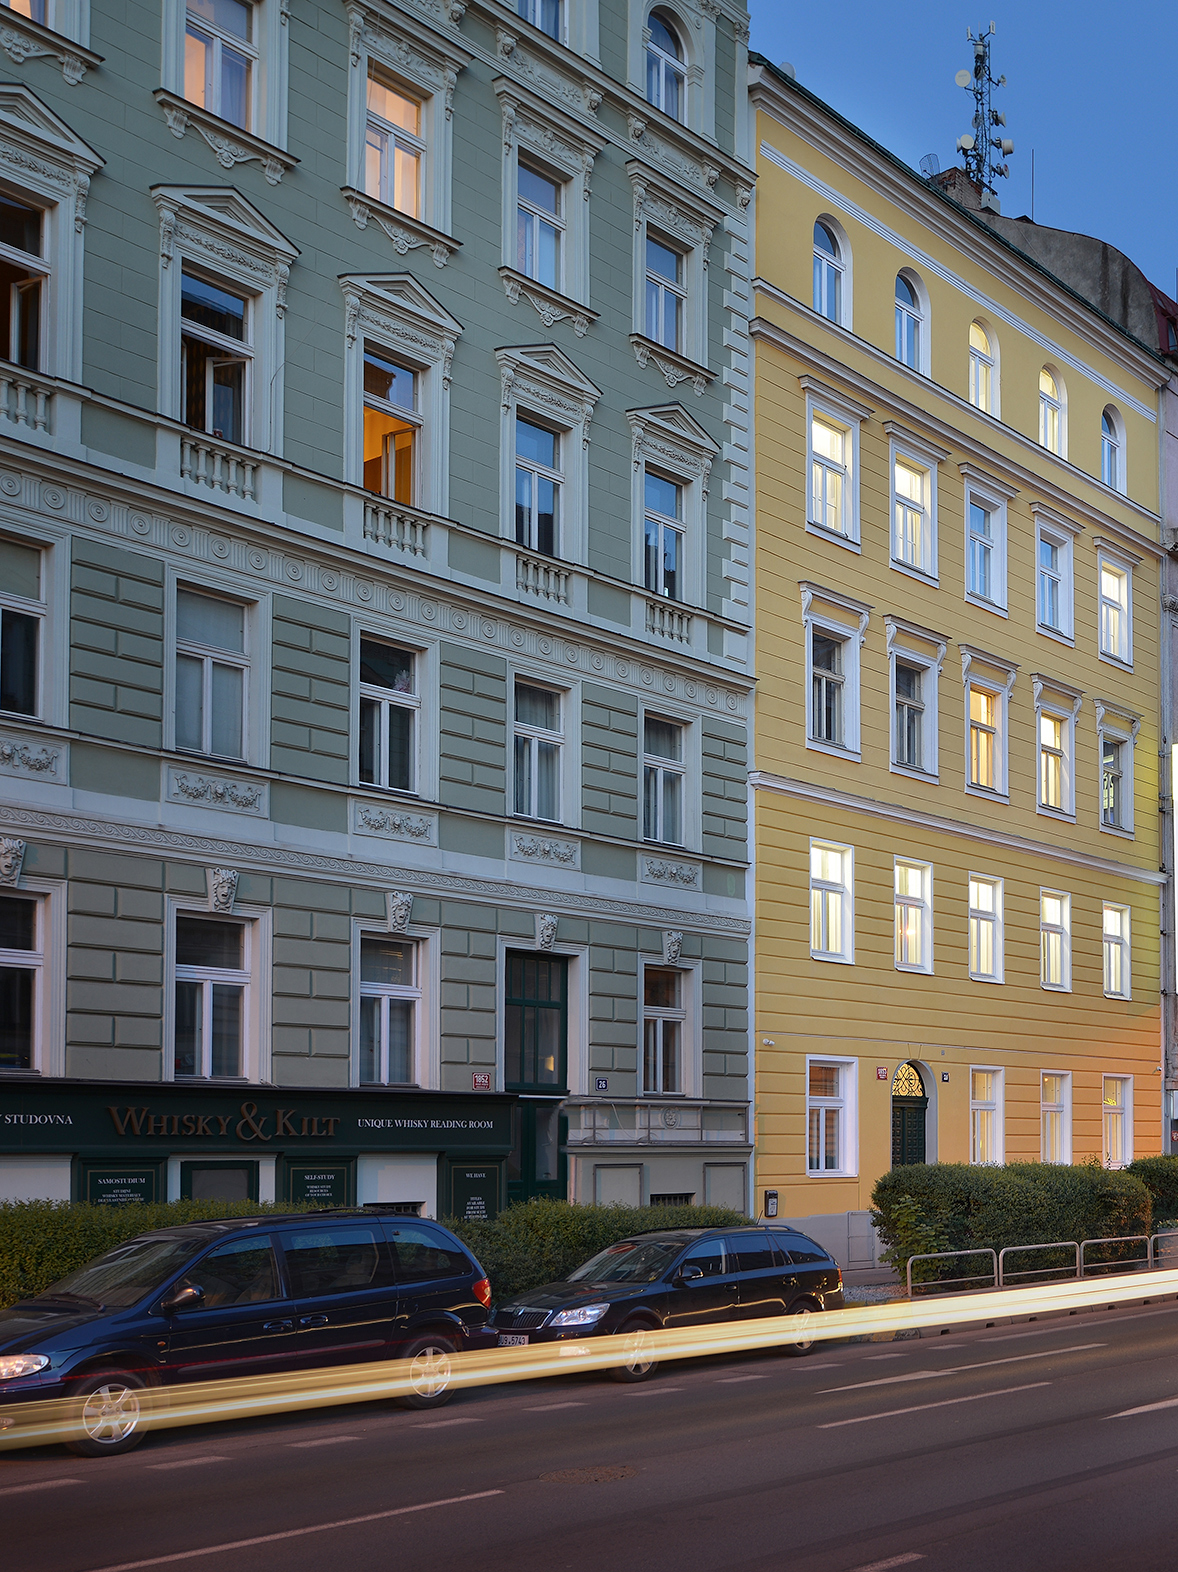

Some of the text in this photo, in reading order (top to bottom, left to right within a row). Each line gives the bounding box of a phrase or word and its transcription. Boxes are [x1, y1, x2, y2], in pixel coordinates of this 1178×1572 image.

[4, 1114, 73, 1124] STUDOVNA
[107, 1101, 340, 1141] WHISKY & KILT
[357, 1119, 494, 1129] UNIQUE WHISKY READING ROOM
